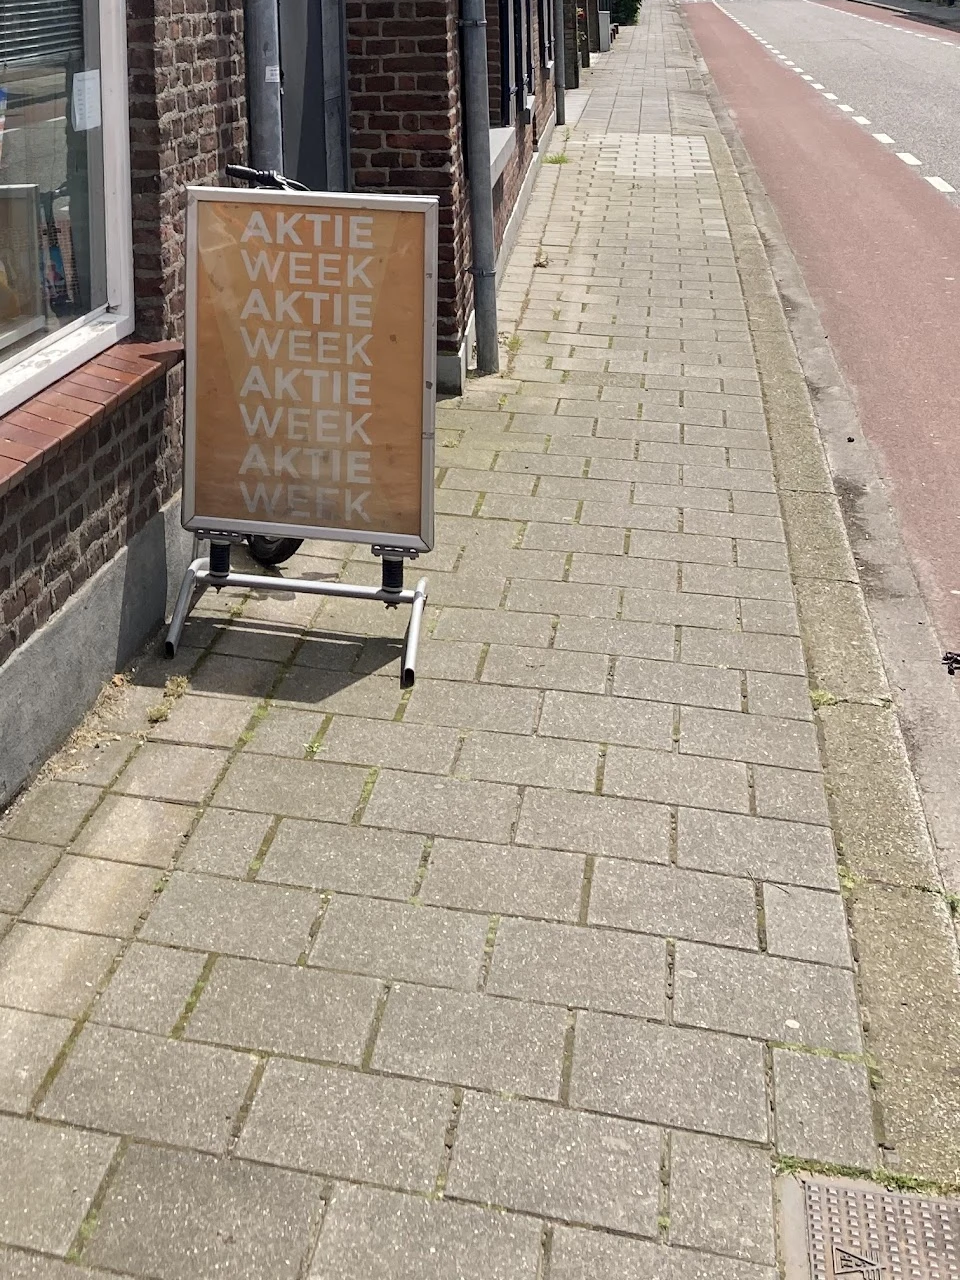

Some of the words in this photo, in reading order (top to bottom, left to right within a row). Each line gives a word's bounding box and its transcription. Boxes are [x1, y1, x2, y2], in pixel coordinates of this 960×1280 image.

[240, 210, 374, 249] AKTIE
[240, 249, 375, 288] WEEK
[240, 288, 373, 328] AKTIE
[240, 326, 373, 366] WEEK
[240, 365, 372, 406] AKTIE
[239, 403, 373, 446] WEEK
[238, 443, 371, 484] AKTIE
